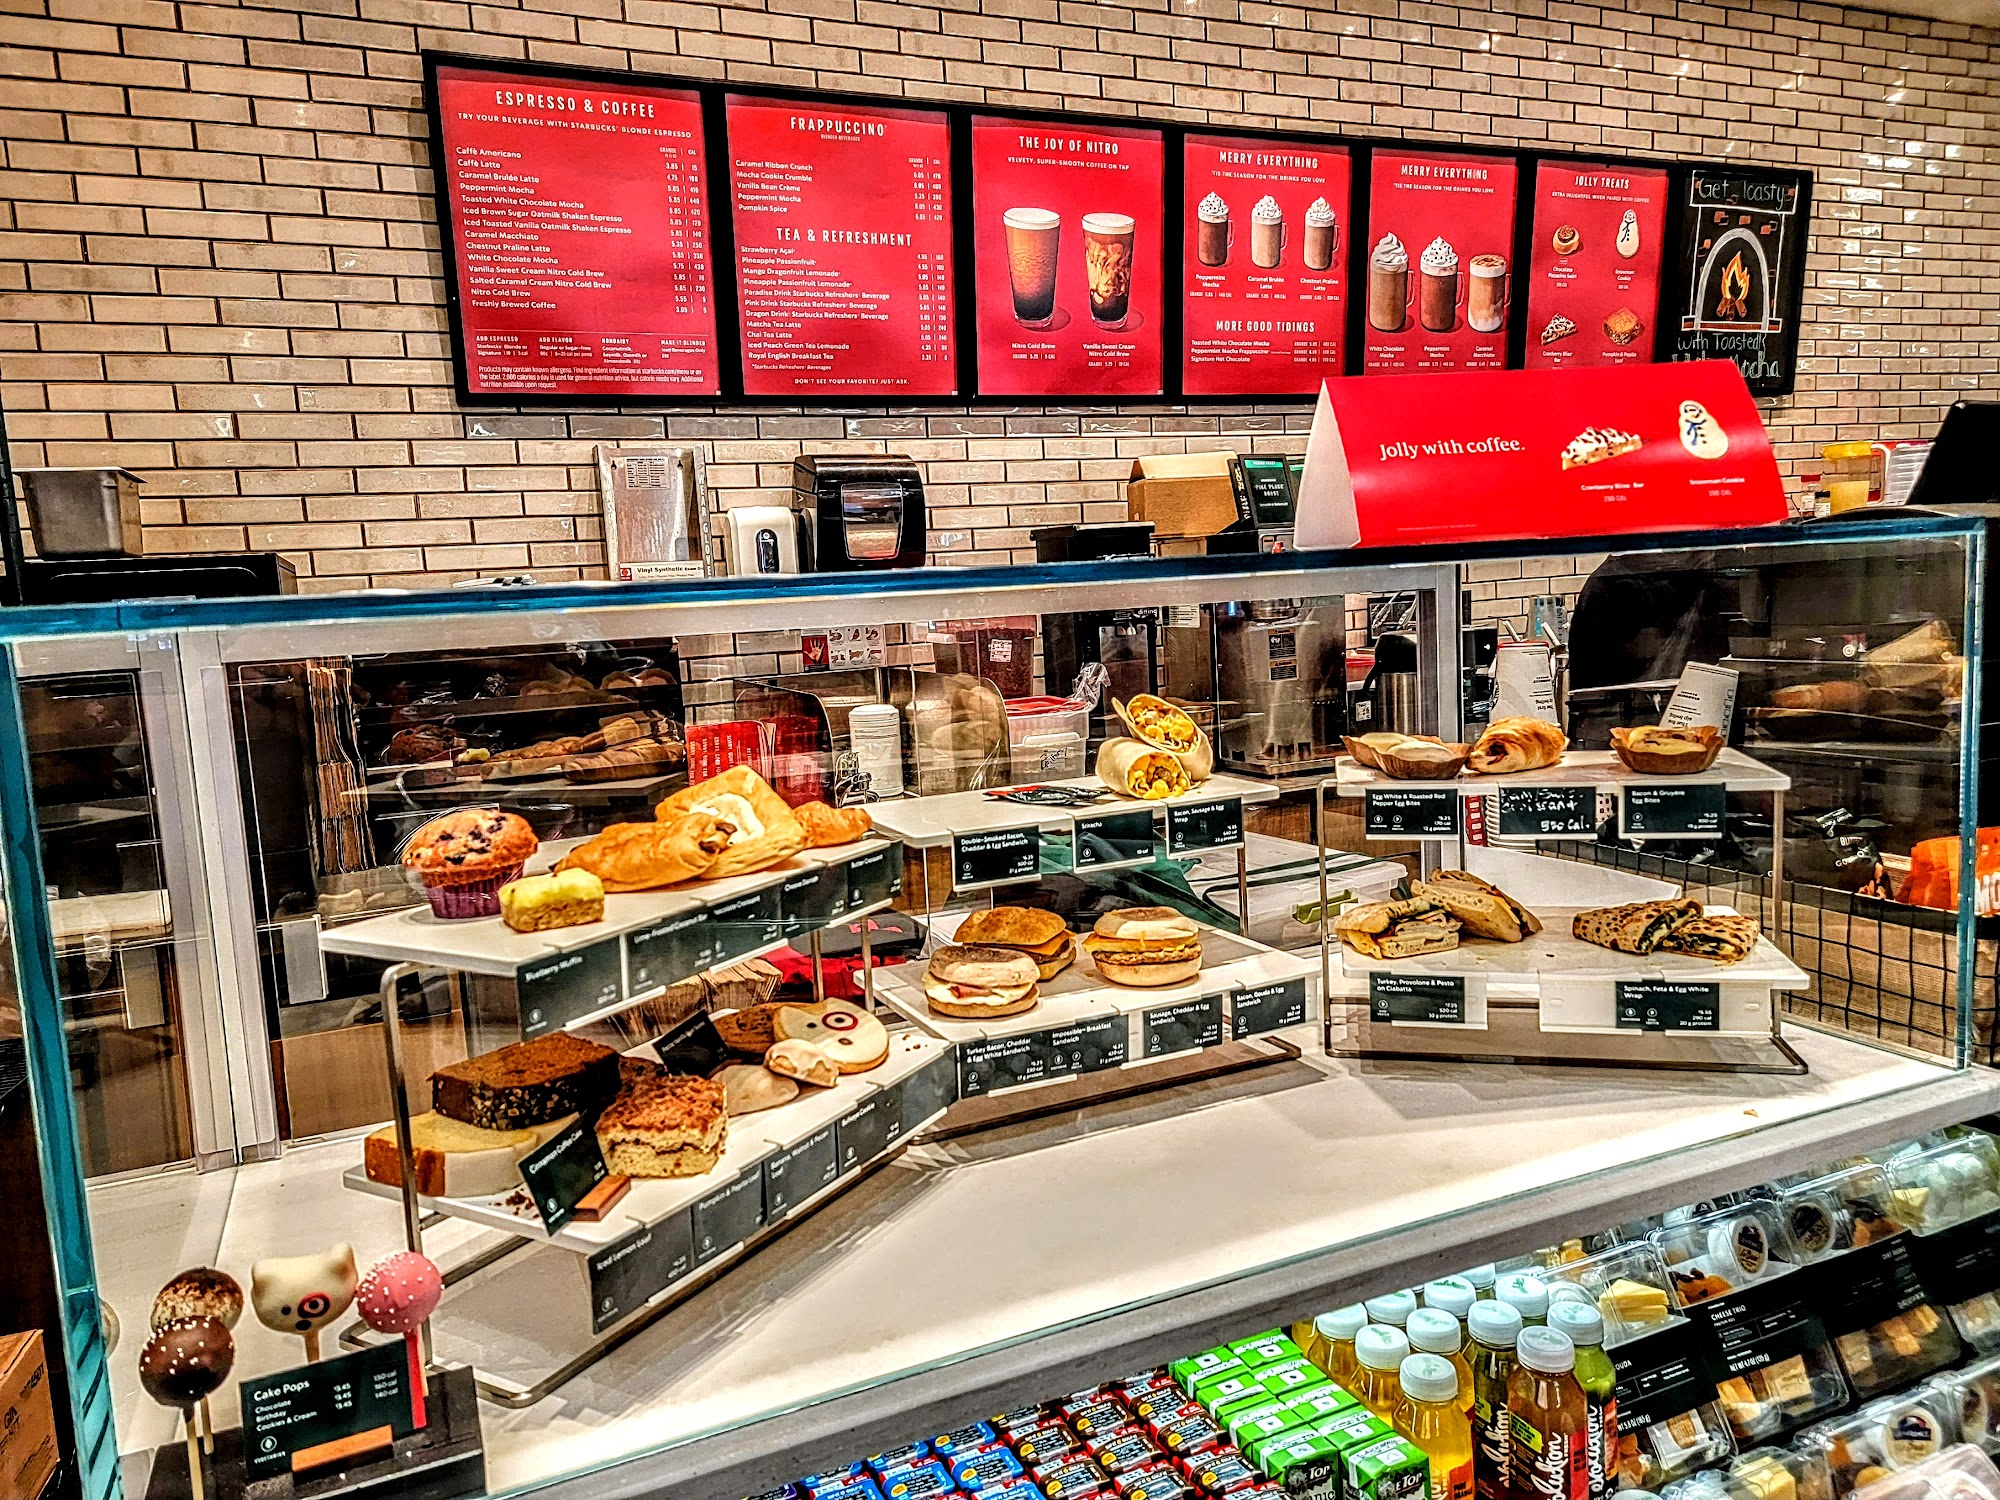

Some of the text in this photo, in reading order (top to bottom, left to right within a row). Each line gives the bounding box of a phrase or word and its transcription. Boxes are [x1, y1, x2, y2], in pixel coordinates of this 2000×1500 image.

[496, 90, 655, 118] ESPRESSO & COFFEE
[458, 112, 473, 120] TRY
[476, 114, 499, 122] YOUR
[502, 116, 544, 126] BEVERAGE
[546, 120, 568, 128] WITH
[621, 126, 651, 135] BLONDE
[654, 129, 692, 138] ESPRESSO
[1019, 135, 1120, 155] THE JOY OF NITRO
[480, 148, 522, 158] Americano
[1219, 151, 1318, 169] MERRY EVERYTHING
[735, 159, 813, 171] Caramel Ribbon Crunch
[1037, 158, 1085, 168] SUPER-SMOOTH
[1086, 161, 1107, 169] COFFEE
[1401, 164, 1488, 180] MERRY EVERYTHING
[1574, 175, 1630, 190] JOLLY TREATS
[1698, 178, 1729, 199] Get
[461, 194, 584, 209] Toasted White Chocolate Mocha
[738, 204, 788, 214] Pumpkin Spice
[465, 230, 539, 241] Caramel Macchiato
[776, 227, 912, 246] TEA & REFRESHMENT
[472, 299, 556, 309] Freshly Brewed Coffee
[746, 320, 802, 329] Matcha Tea Latte
[1216, 320, 1315, 333] MORE GOOD TIDINGS
[847, 378, 879, 386] FAVORITE?
[880, 378, 895, 386] JUST
[1380, 437, 1526, 461] Jolly with coffee.
[1081, 821, 1103, 829] Sriracha
[961, 834, 1006, 845] Double-Smoked
[961, 844, 985, 852] Cheddar
[1002, 839, 1028, 848] Sandwich
[1376, 978, 1399, 986] Turkey,
[966, 1047, 986, 1055] Turkey
[1006, 1038, 1031, 1047] Cheddar
[1711, 1304, 1747, 1321] CHEESE TRIO
[1615, 1360, 1632, 1371] OUDA
[253, 1380, 310, 1402] Cake Pops
[254, 1400, 292, 1415] Chocolate
[256, 1410, 287, 1424] Birthday
[256, 1411, 318, 1432] Cookies & Cream
